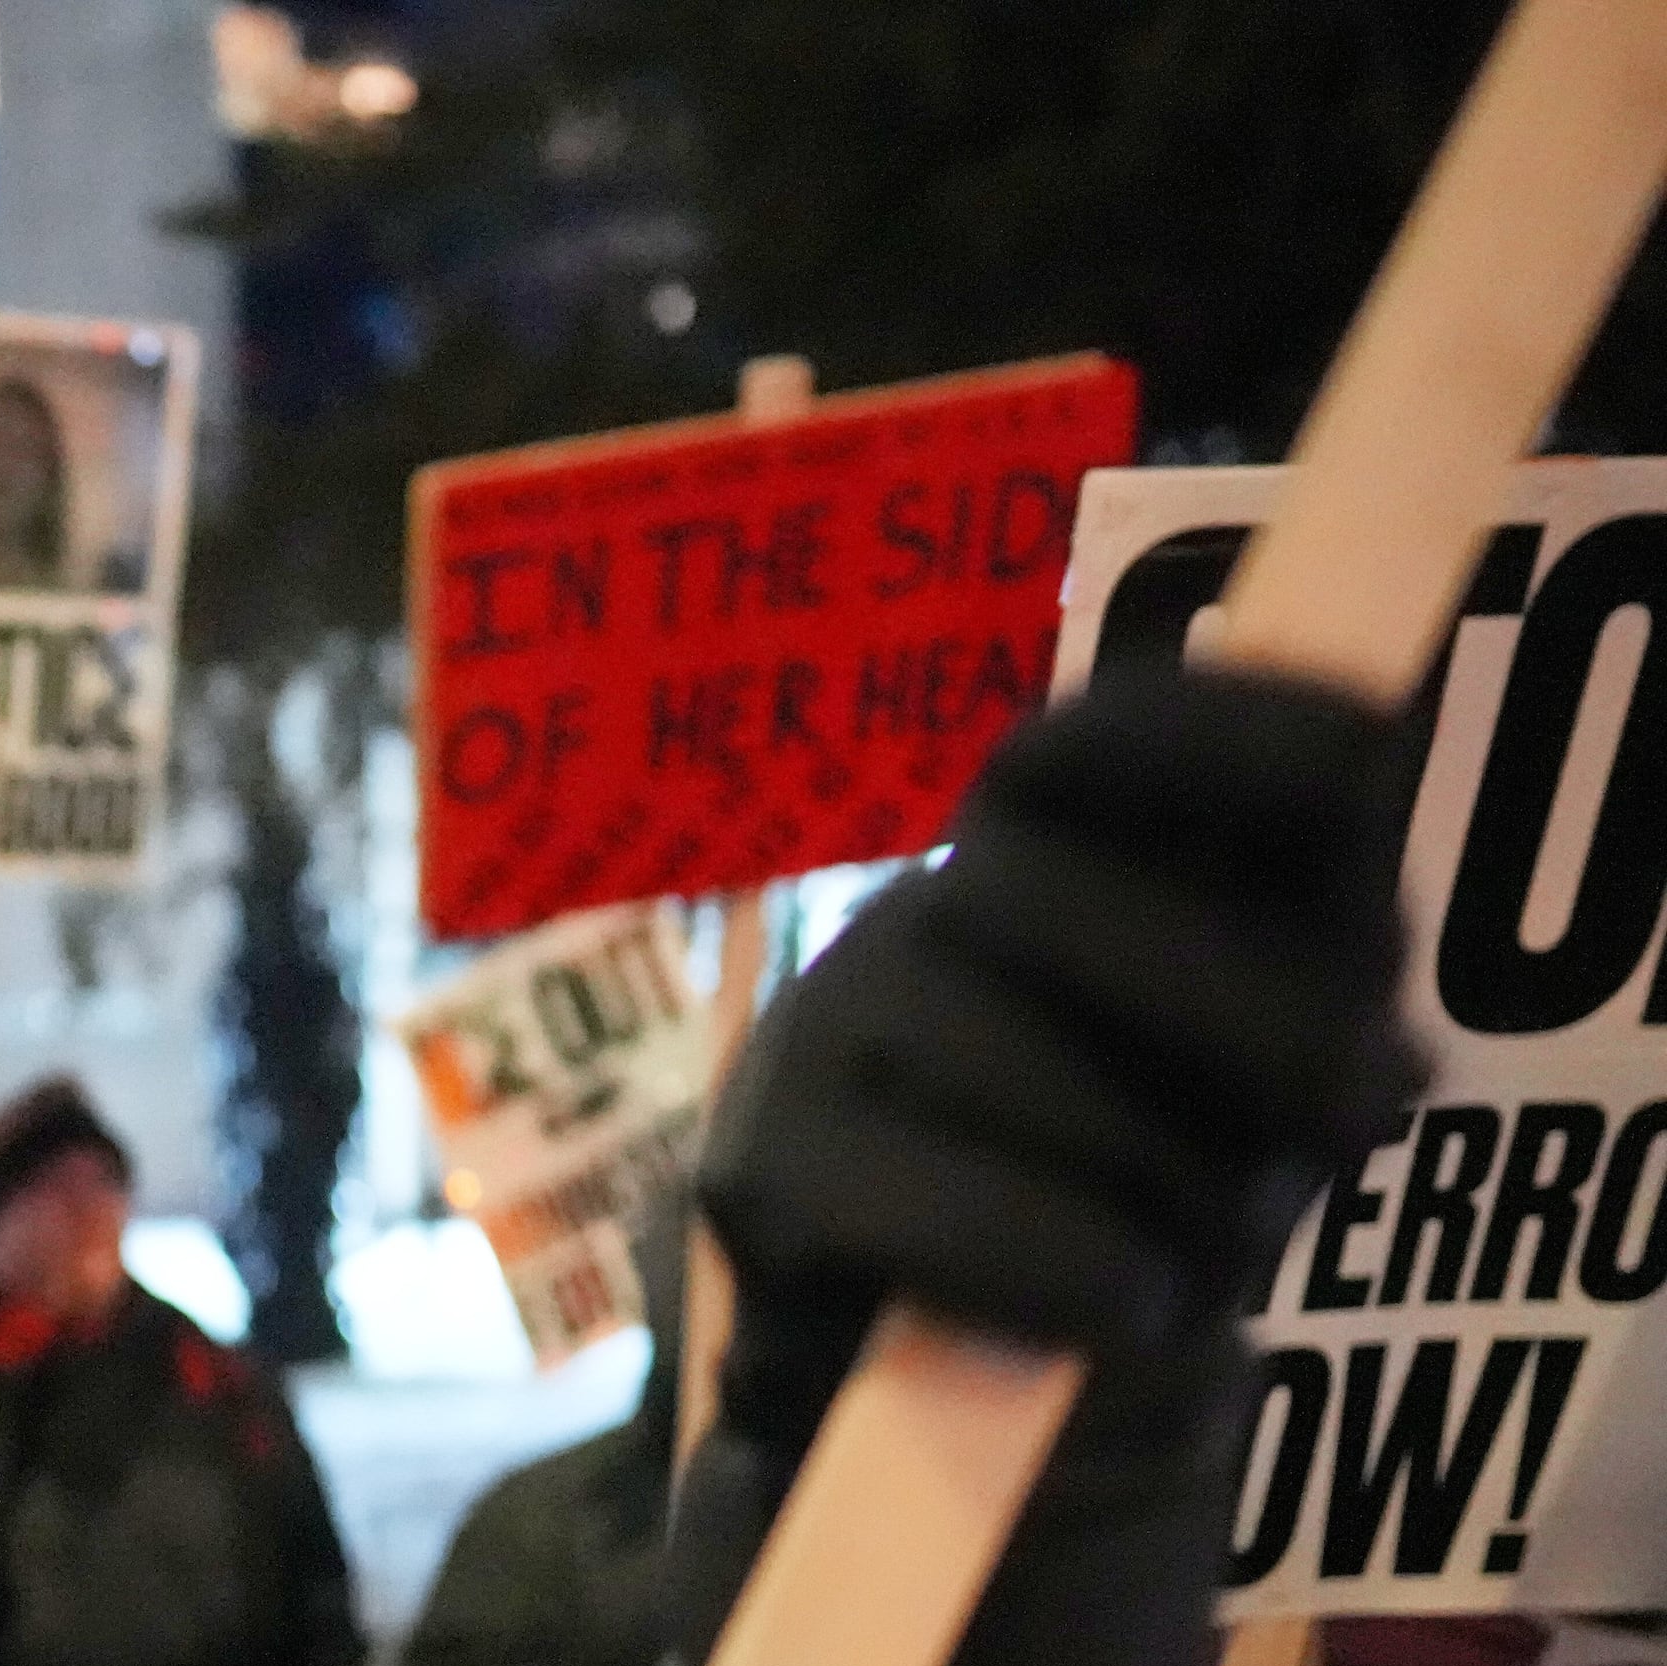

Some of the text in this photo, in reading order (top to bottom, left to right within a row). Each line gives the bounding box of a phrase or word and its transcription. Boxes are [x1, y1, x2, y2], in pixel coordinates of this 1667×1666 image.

[447, 535, 610, 665] IN
[639, 500, 829, 635] THE
[439, 685, 591, 802] OF
[645, 658, 821, 770] HER
